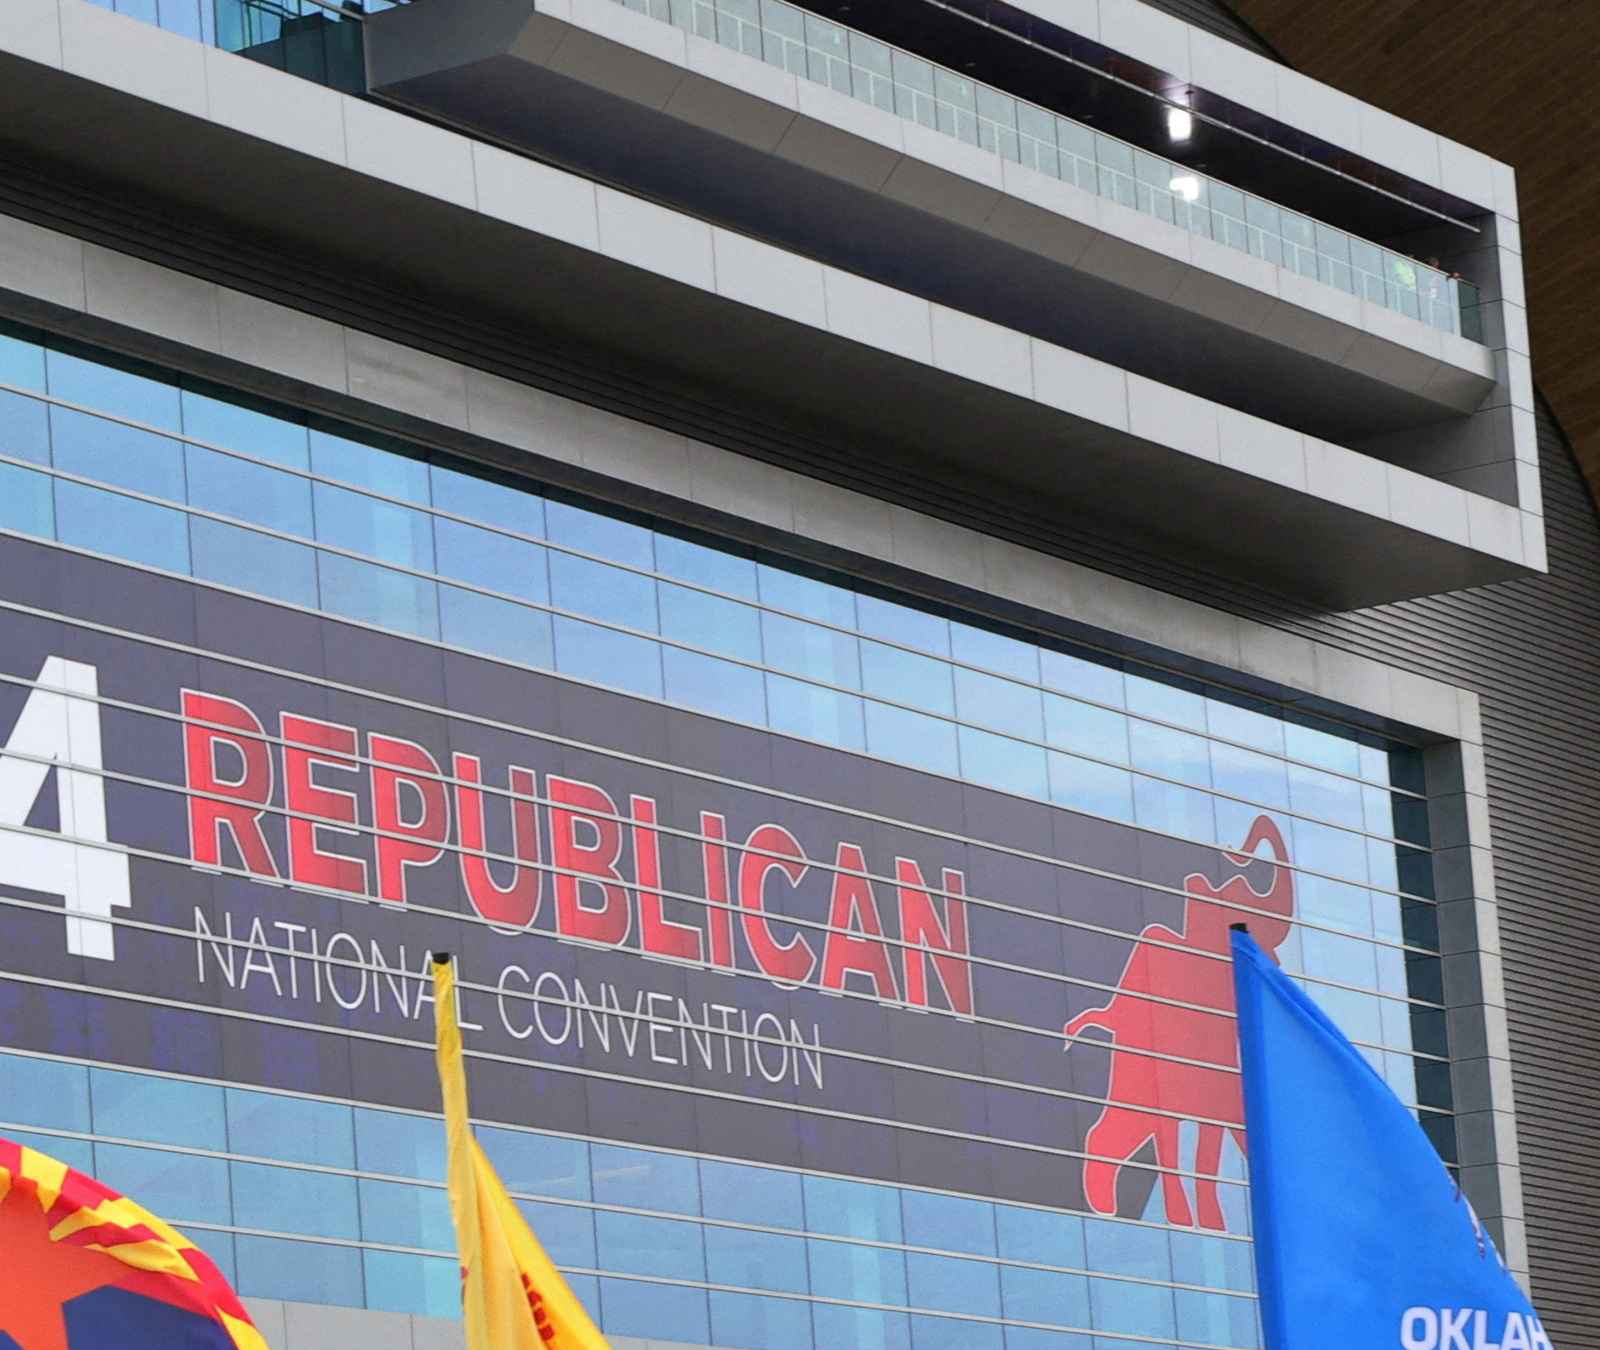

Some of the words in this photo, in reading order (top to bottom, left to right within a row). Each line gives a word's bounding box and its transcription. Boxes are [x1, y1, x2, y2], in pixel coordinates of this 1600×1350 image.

[181, 688, 976, 1022] REPUBLICAN
[194, 906, 483, 1032] NATIONAL
[499, 964, 824, 1090] CONVENTION
